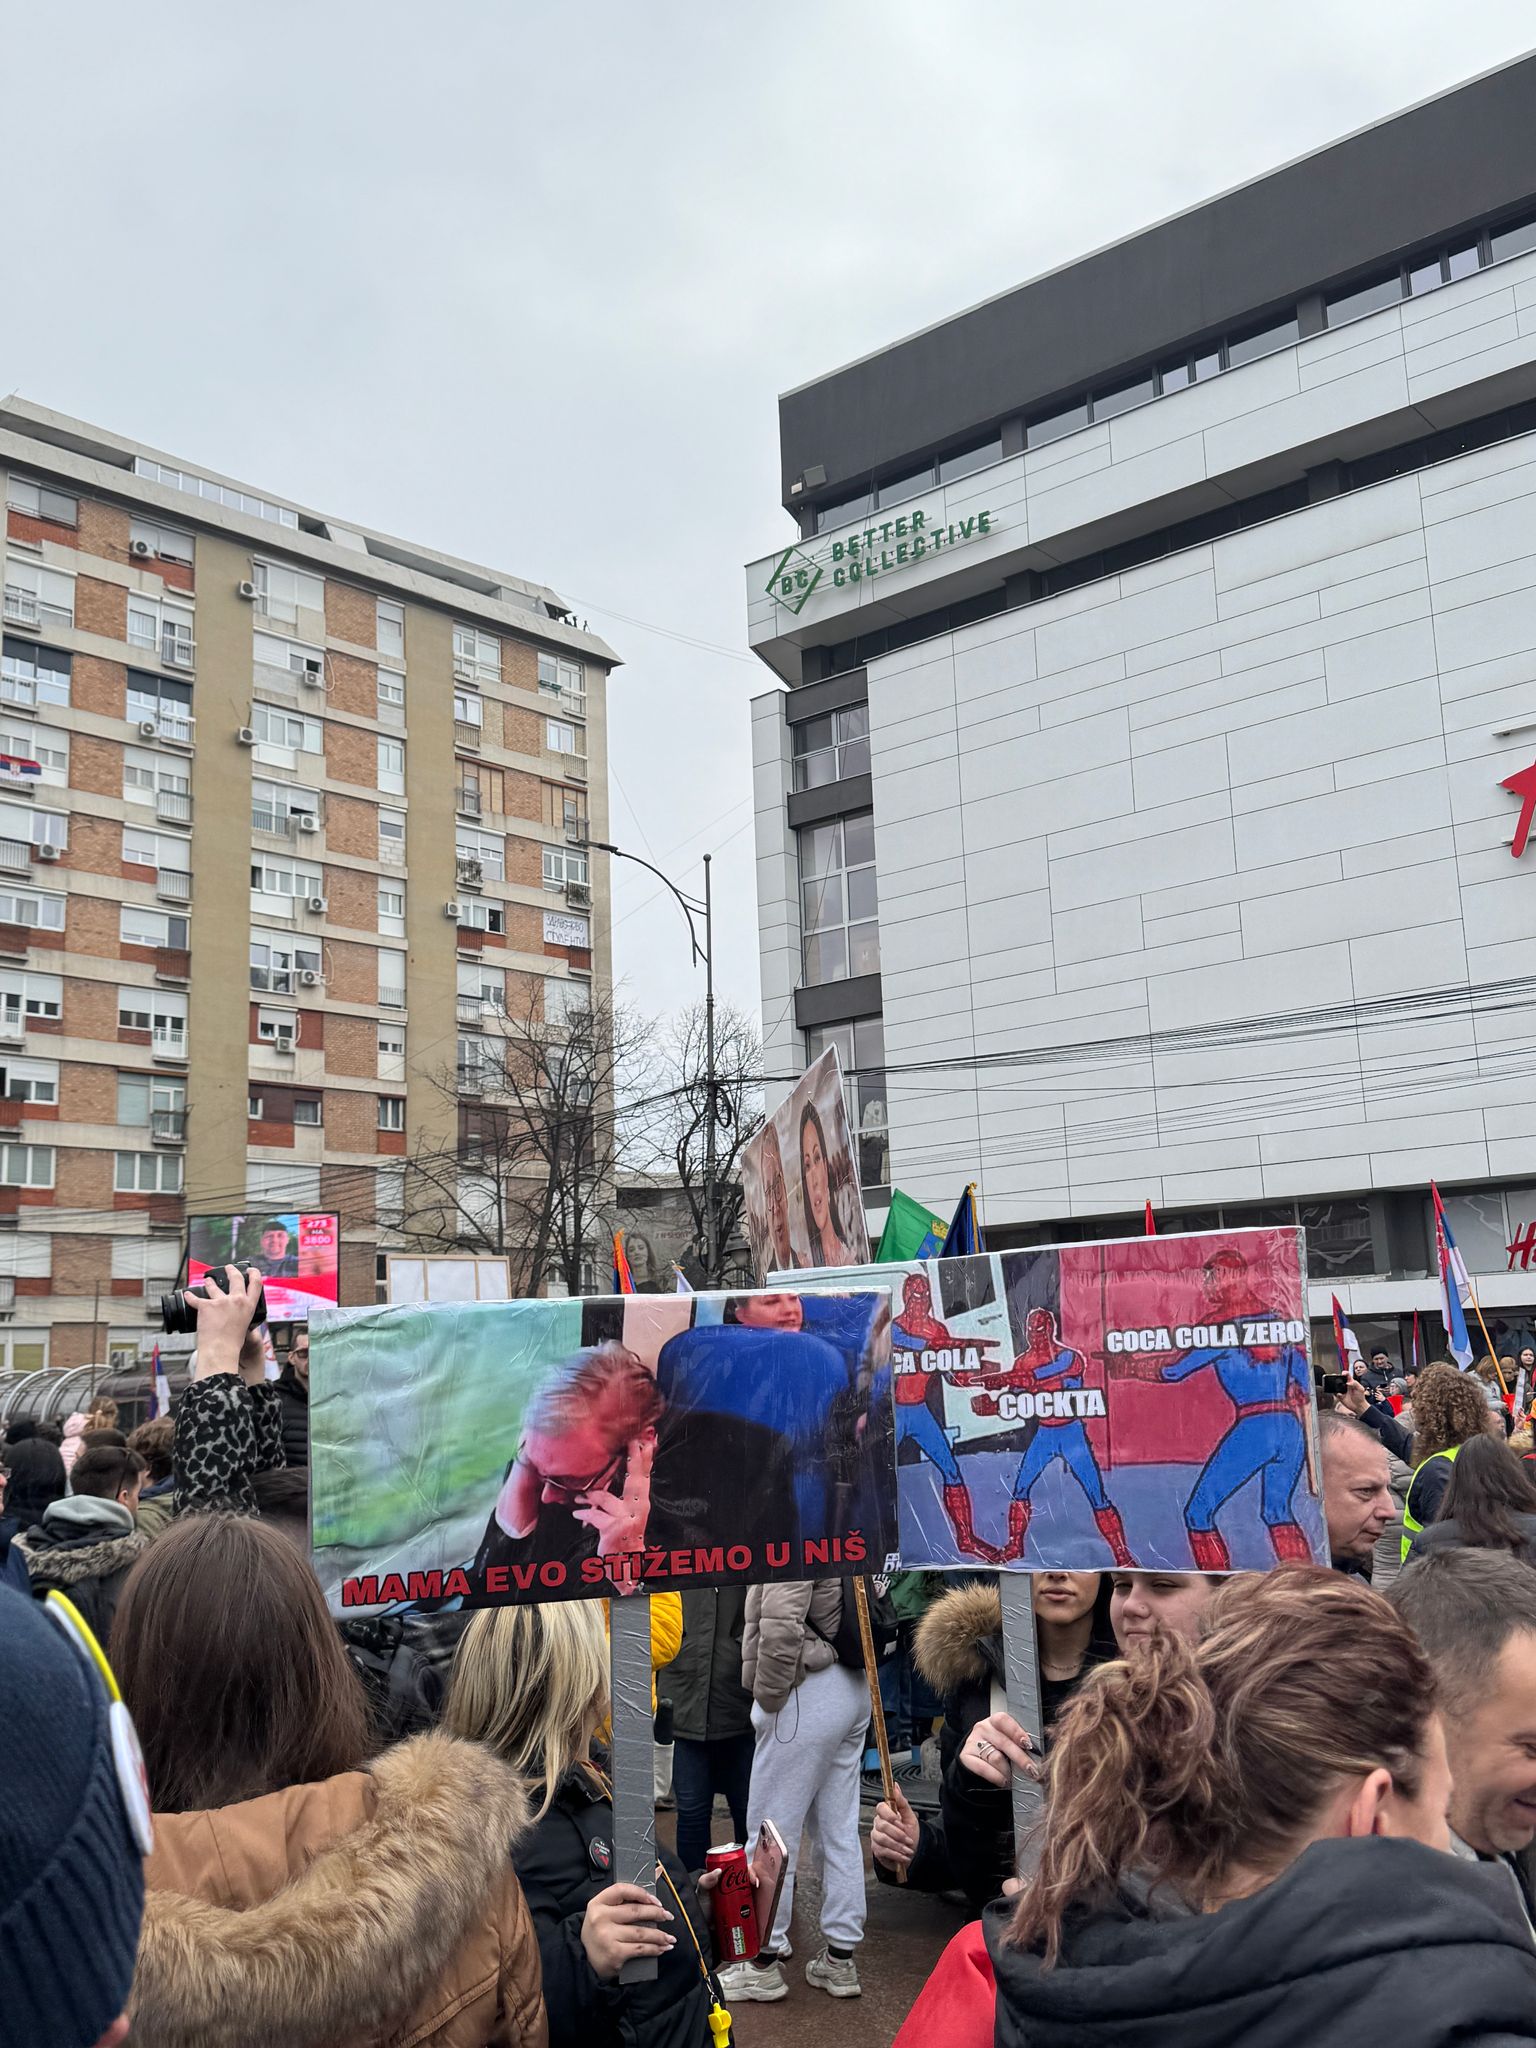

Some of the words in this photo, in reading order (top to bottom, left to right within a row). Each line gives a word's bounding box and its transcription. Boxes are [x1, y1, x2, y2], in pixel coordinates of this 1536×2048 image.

[832, 510, 925, 562] BETTER
[833, 510, 991, 587] COLLECTIVE
[781, 569, 809, 595] BC
[1106, 1328, 1172, 1353] COCA
[1175, 1324, 1239, 1348] COLA
[1242, 1320, 1304, 1346] ZERO
[921, 1347, 981, 1372] COLA
[1000, 1389, 1106, 1419] COCKTA
[342, 1568, 471, 1606] MAMA
[486, 1560, 568, 1593] EVO
[580, 1545, 752, 1583] STIŽEMO
[766, 1541, 790, 1567] U
[804, 1530, 867, 1565] NIŠ
